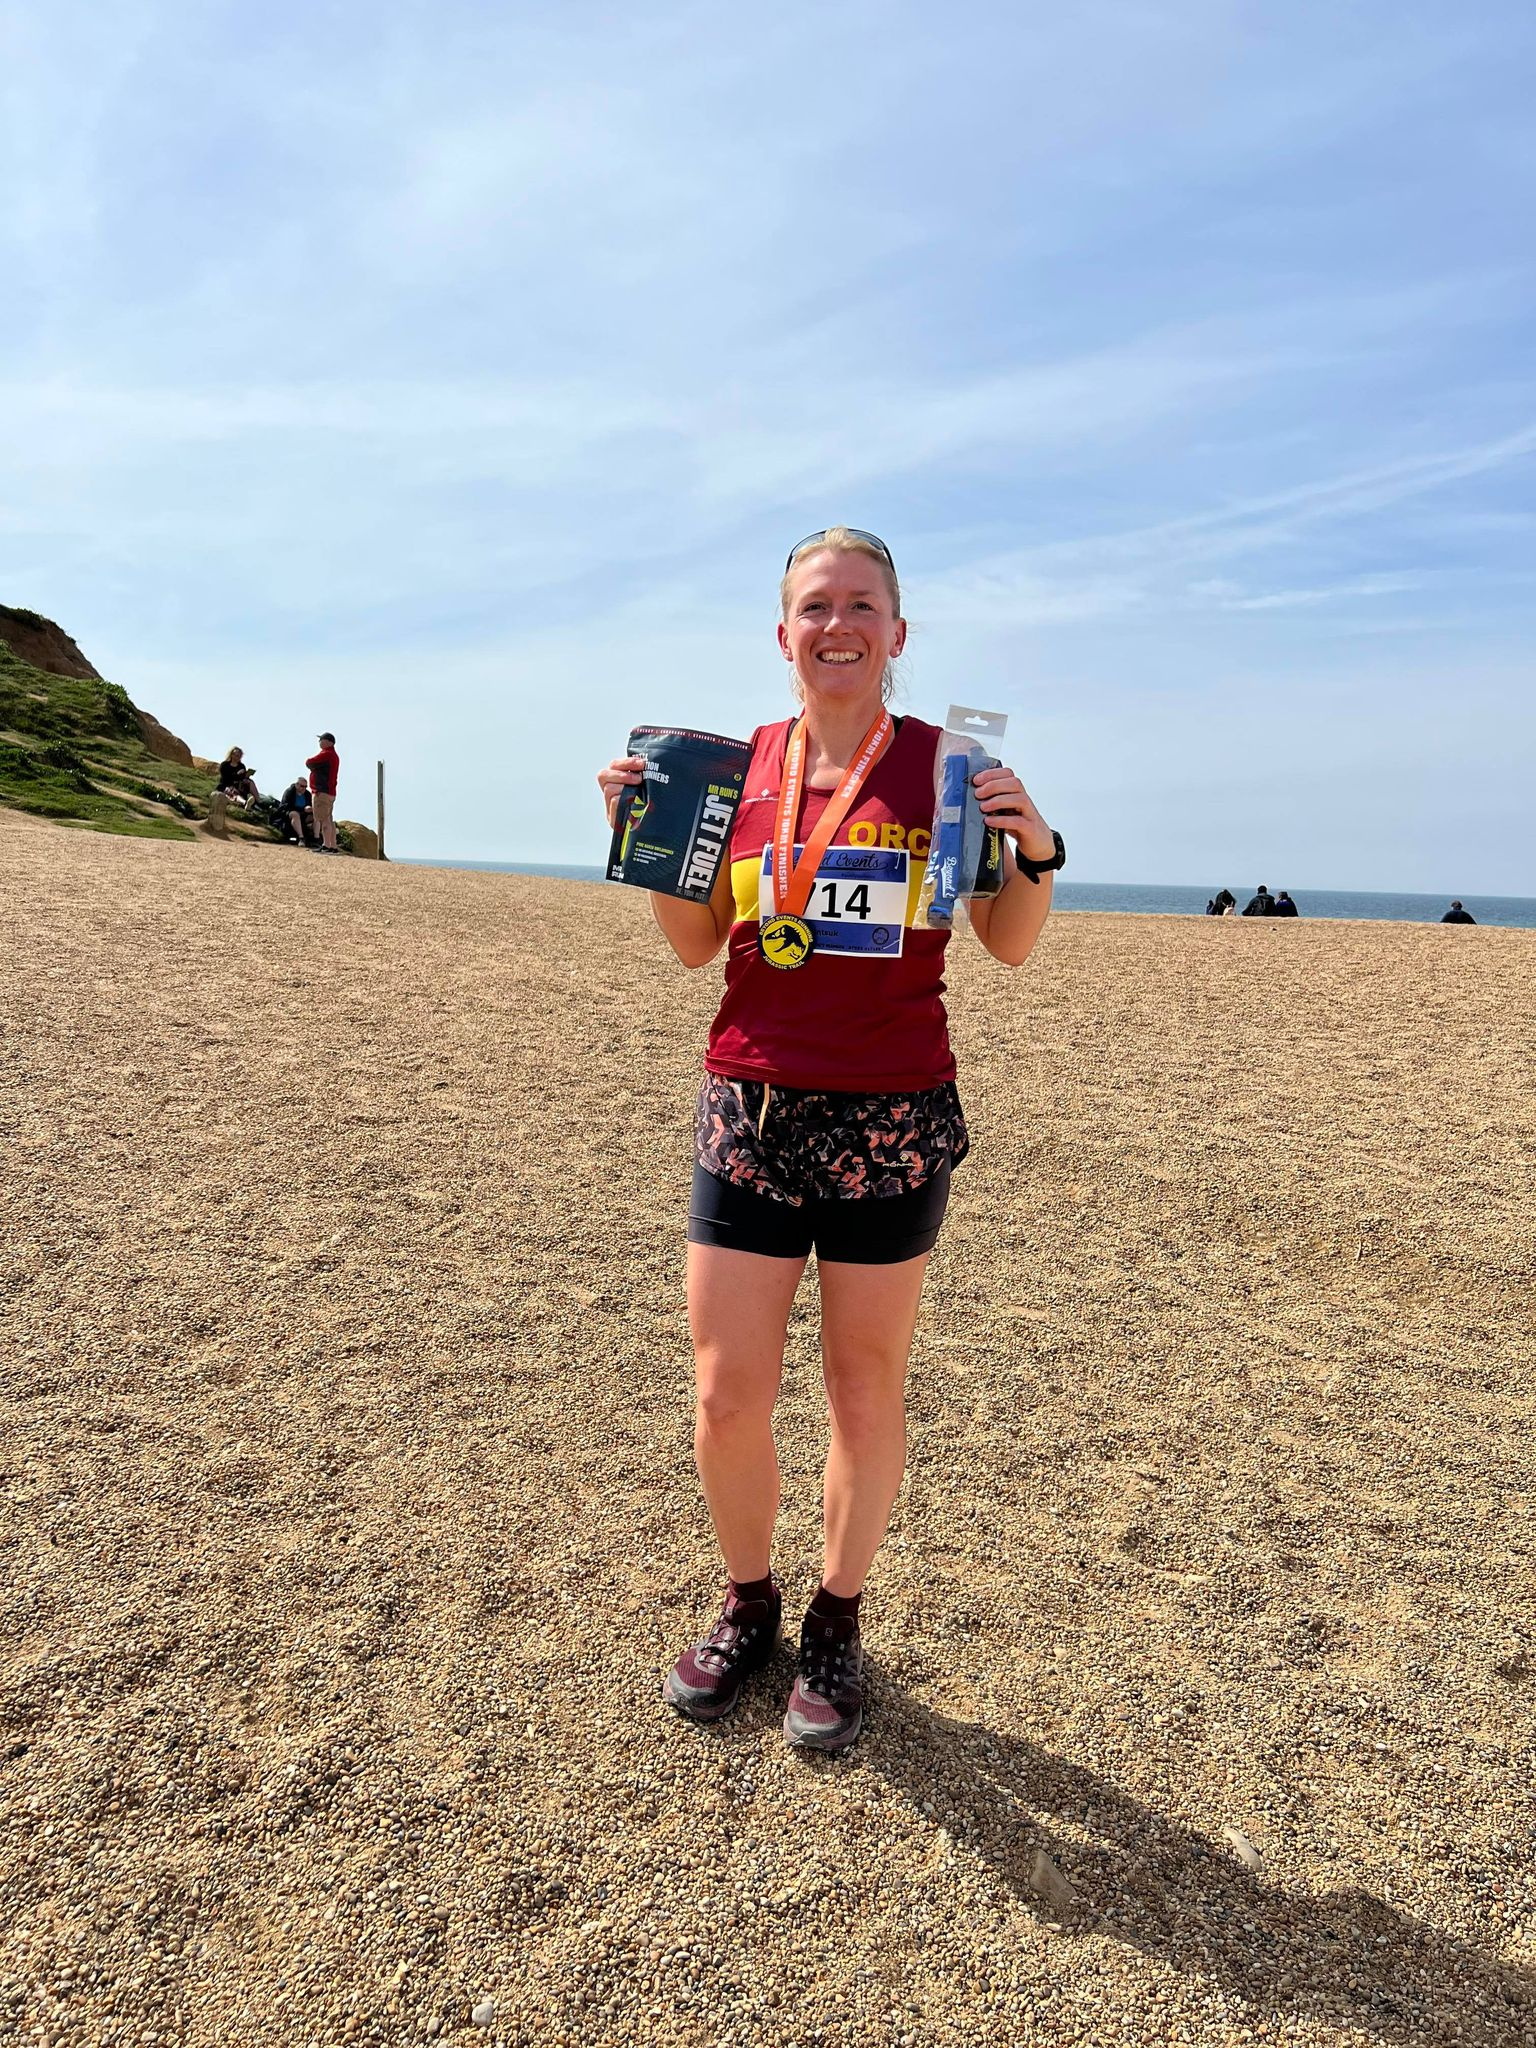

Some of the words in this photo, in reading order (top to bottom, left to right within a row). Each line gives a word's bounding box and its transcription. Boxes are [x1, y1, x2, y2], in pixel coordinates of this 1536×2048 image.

[789, 738, 801, 776] BEYOND
[707, 784, 719, 794] MR
[719, 787, 739, 800] RUN'S
[841, 755, 871, 798] FINISHER
[783, 778, 797, 816] EVENTS
[700, 794, 734, 840] JET
[780, 817, 792, 846] 10KM
[848, 820, 931, 856] ORC
[684, 837, 722, 889] FUEL
[778, 847, 789, 899] FINISHER
[836, 852, 880, 868] Events
[945, 855, 958, 892] Beyond
[762, 955, 788, 970] JURASSIC
[789, 960, 805, 970] TRAIL
